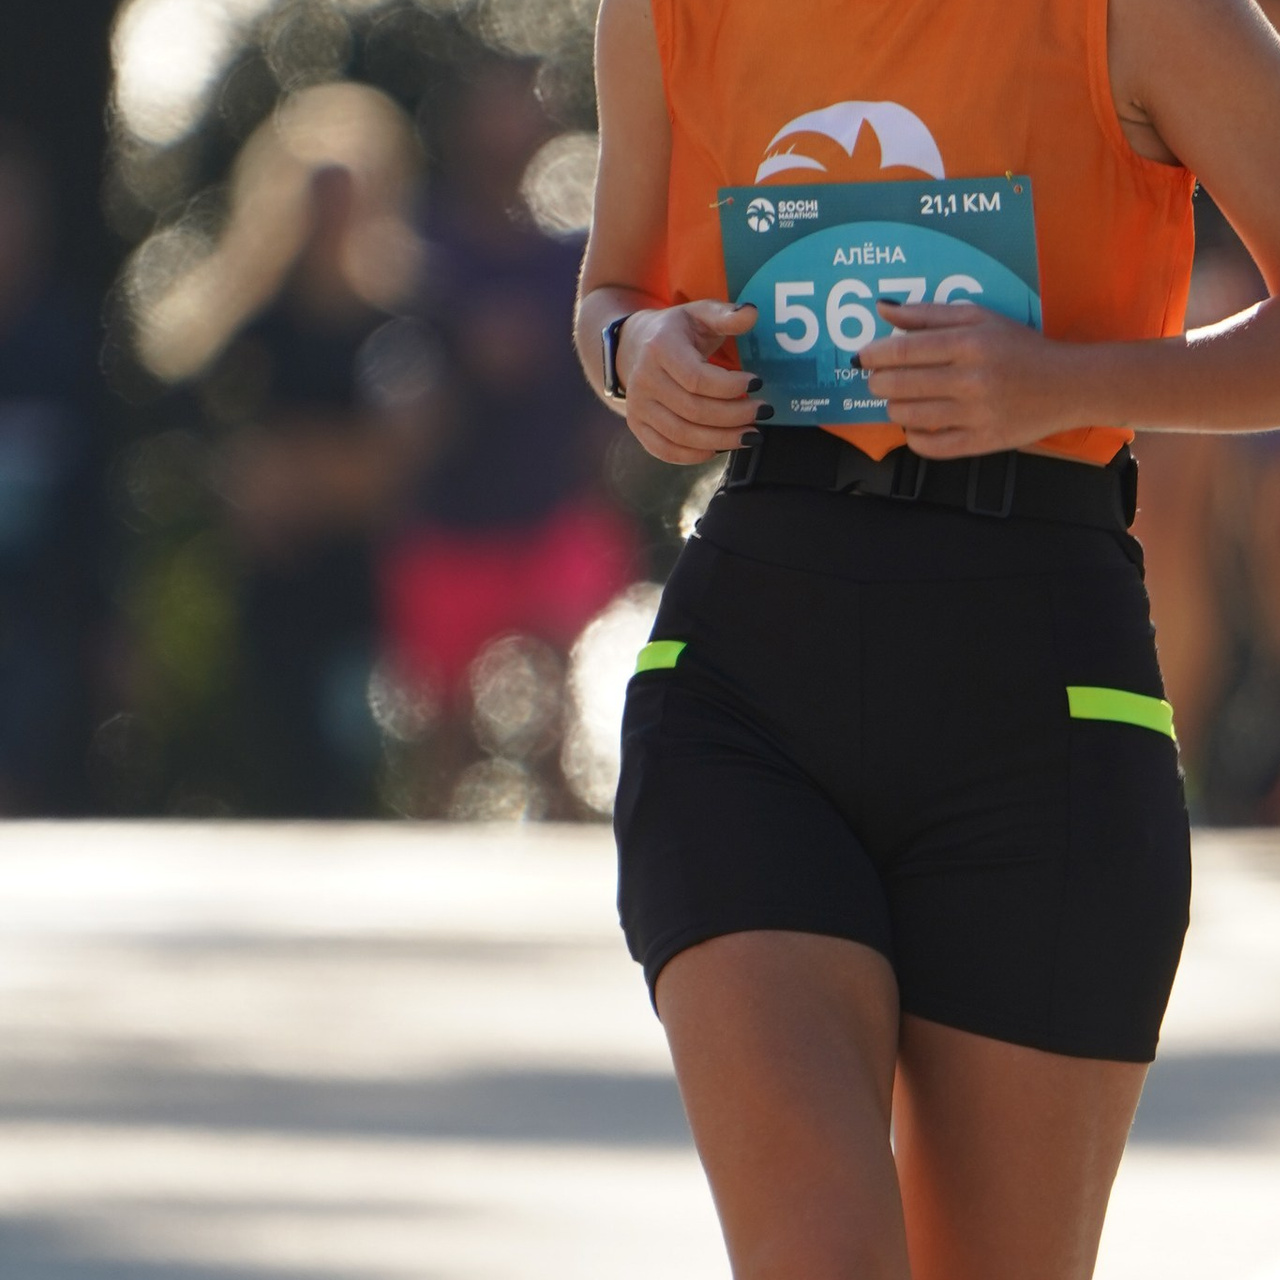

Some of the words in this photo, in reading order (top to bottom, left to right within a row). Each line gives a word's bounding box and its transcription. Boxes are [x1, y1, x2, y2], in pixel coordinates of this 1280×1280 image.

[778, 200, 818, 212] SOCHI
[920, 194, 957, 217] 21,1
[963, 192, 1001, 213] KM
[778, 211, 818, 220] MARATHON
[833, 242, 906, 265] АЛЁНА
[854, 399, 888, 408] МАГНИТ
